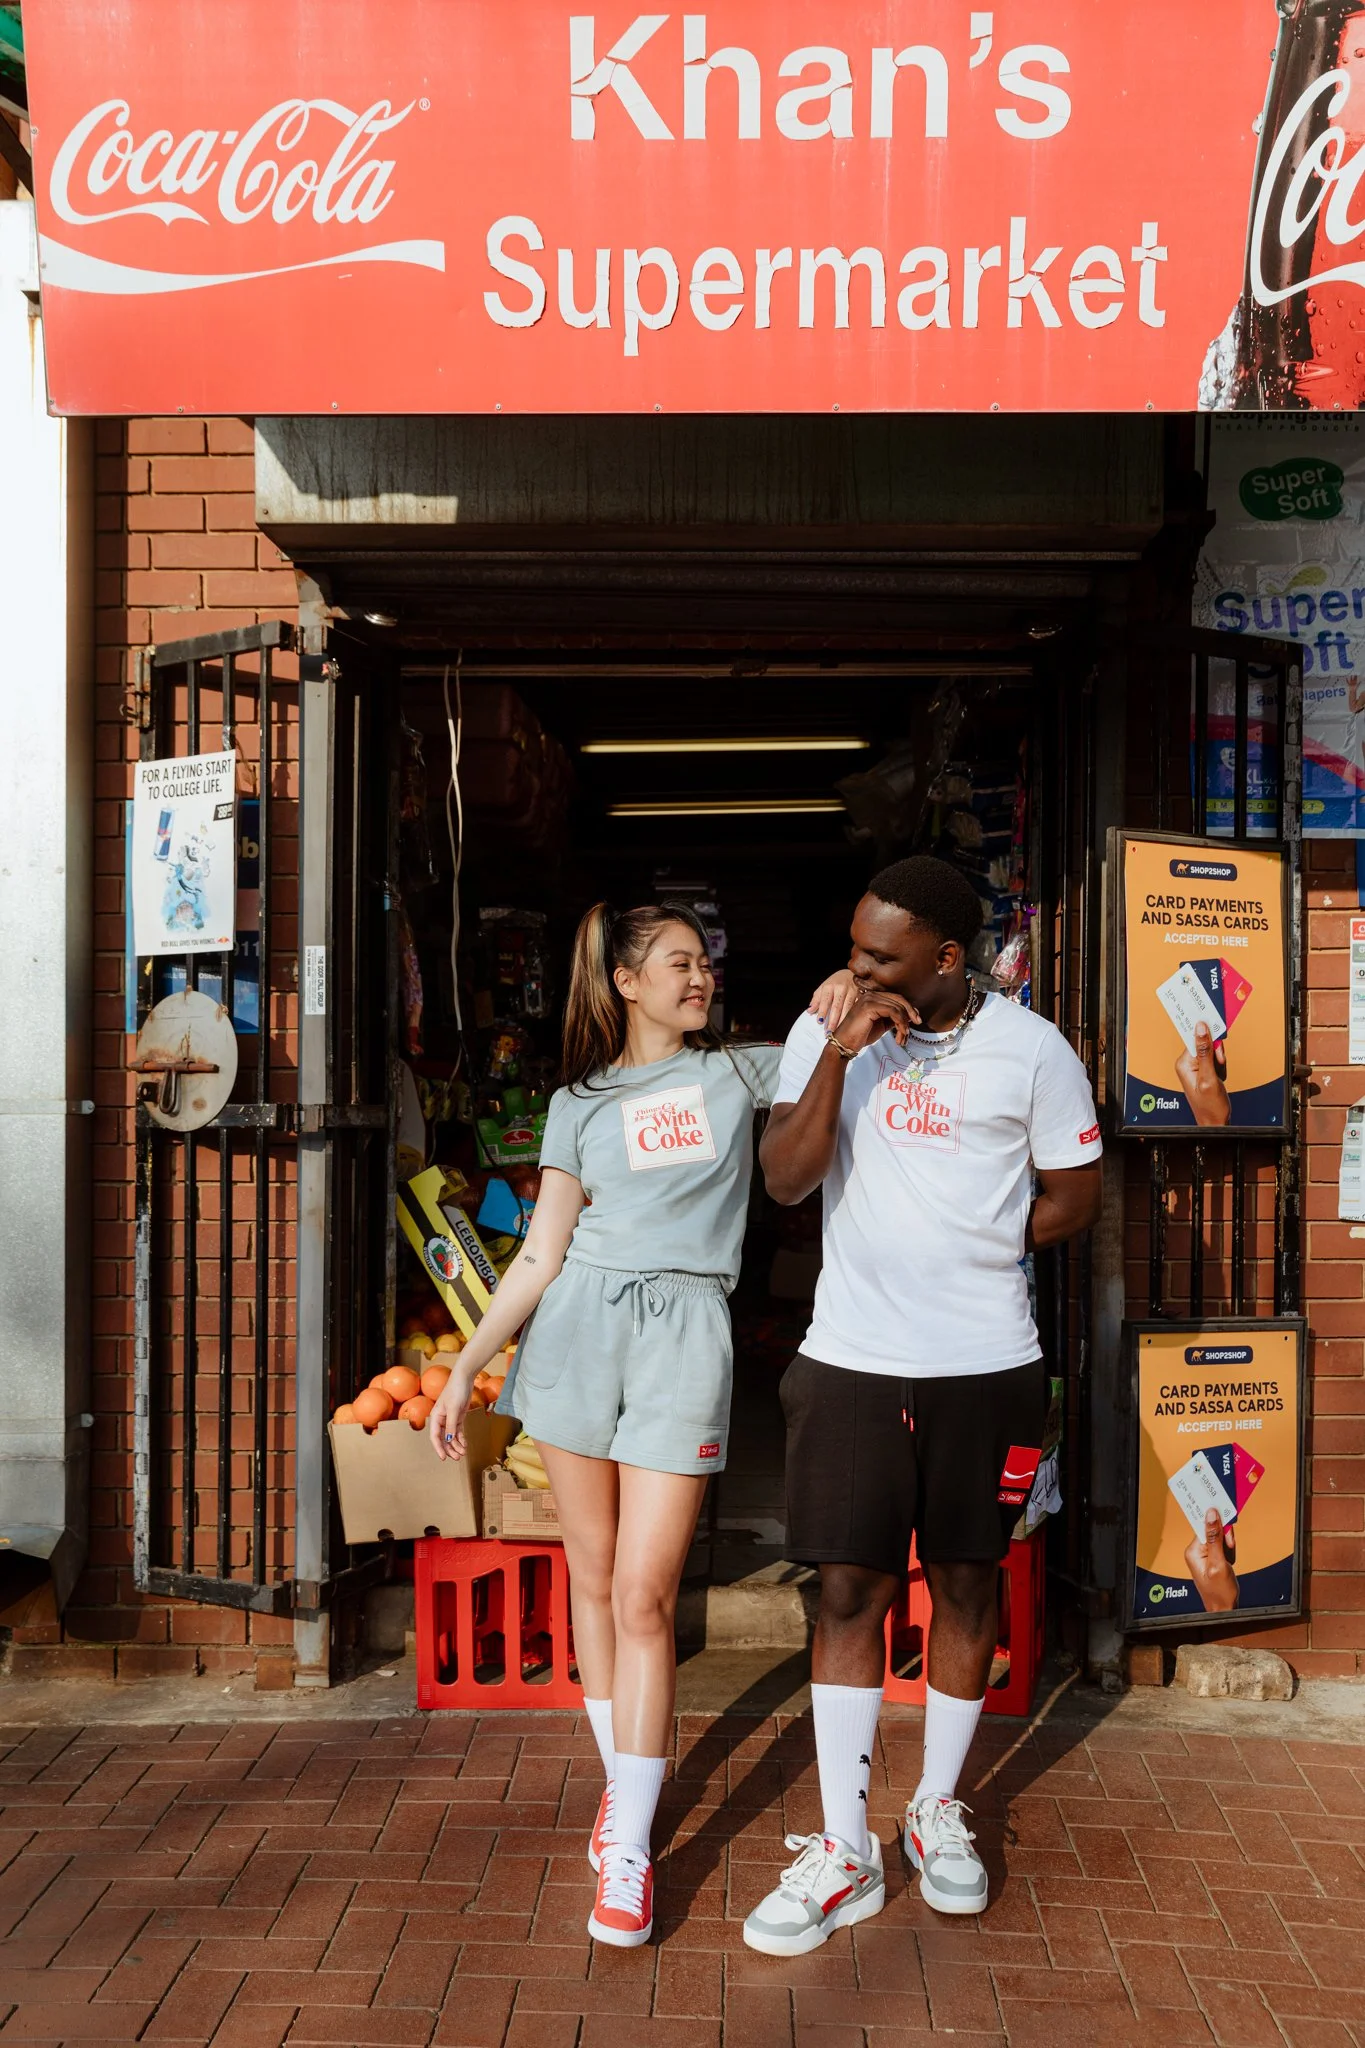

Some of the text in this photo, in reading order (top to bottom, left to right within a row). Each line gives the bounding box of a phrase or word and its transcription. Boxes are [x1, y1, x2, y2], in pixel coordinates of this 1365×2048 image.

[569, 12, 1072, 141] Khan's
[50, 98, 416, 226] Coca-Cola
[483, 215, 1168, 357] Supermarket
[1251, 466, 1326, 495] Super
[1277, 488, 1331, 514] Soft
[1214, 588, 1365, 638] Super
[1302, 686, 1346, 701] iapers
[142, 759, 232, 783] FOR A FLYING START
[148, 778, 222, 800] TO COLLEGE LIFE.
[1190, 866, 1231, 876] SHOP2SHOP
[1145, 894, 1263, 914] CARD PAYMENTS
[1141, 911, 1269, 931] AND SASSA CARDS
[1164, 932, 1249, 947] ACCEPTED HERE
[1210, 966, 1219, 990] VISA
[1188, 986, 1207, 1011] sassa
[906, 1093, 951, 1117] With
[1156, 1097, 1179, 1109] flash
[652, 1110, 697, 1128] With
[885, 1103, 950, 1137] Coke
[637, 1126, 704, 1152] Coke
[455, 1220, 497, 1286] LEBOMBO
[1205, 1351, 1247, 1360] SHOP2SHOP
[1160, 1382, 1279, 1399] CARD PAYMENTS
[1154, 1398, 1284, 1416] AND SASSA CARDS
[1177, 1418, 1263, 1433] ACCEPTED HERE
[1222, 1451, 1231, 1476] VISA
[1200, 1474, 1218, 1497] sassa
[1165, 1585, 1188, 1598] flash
